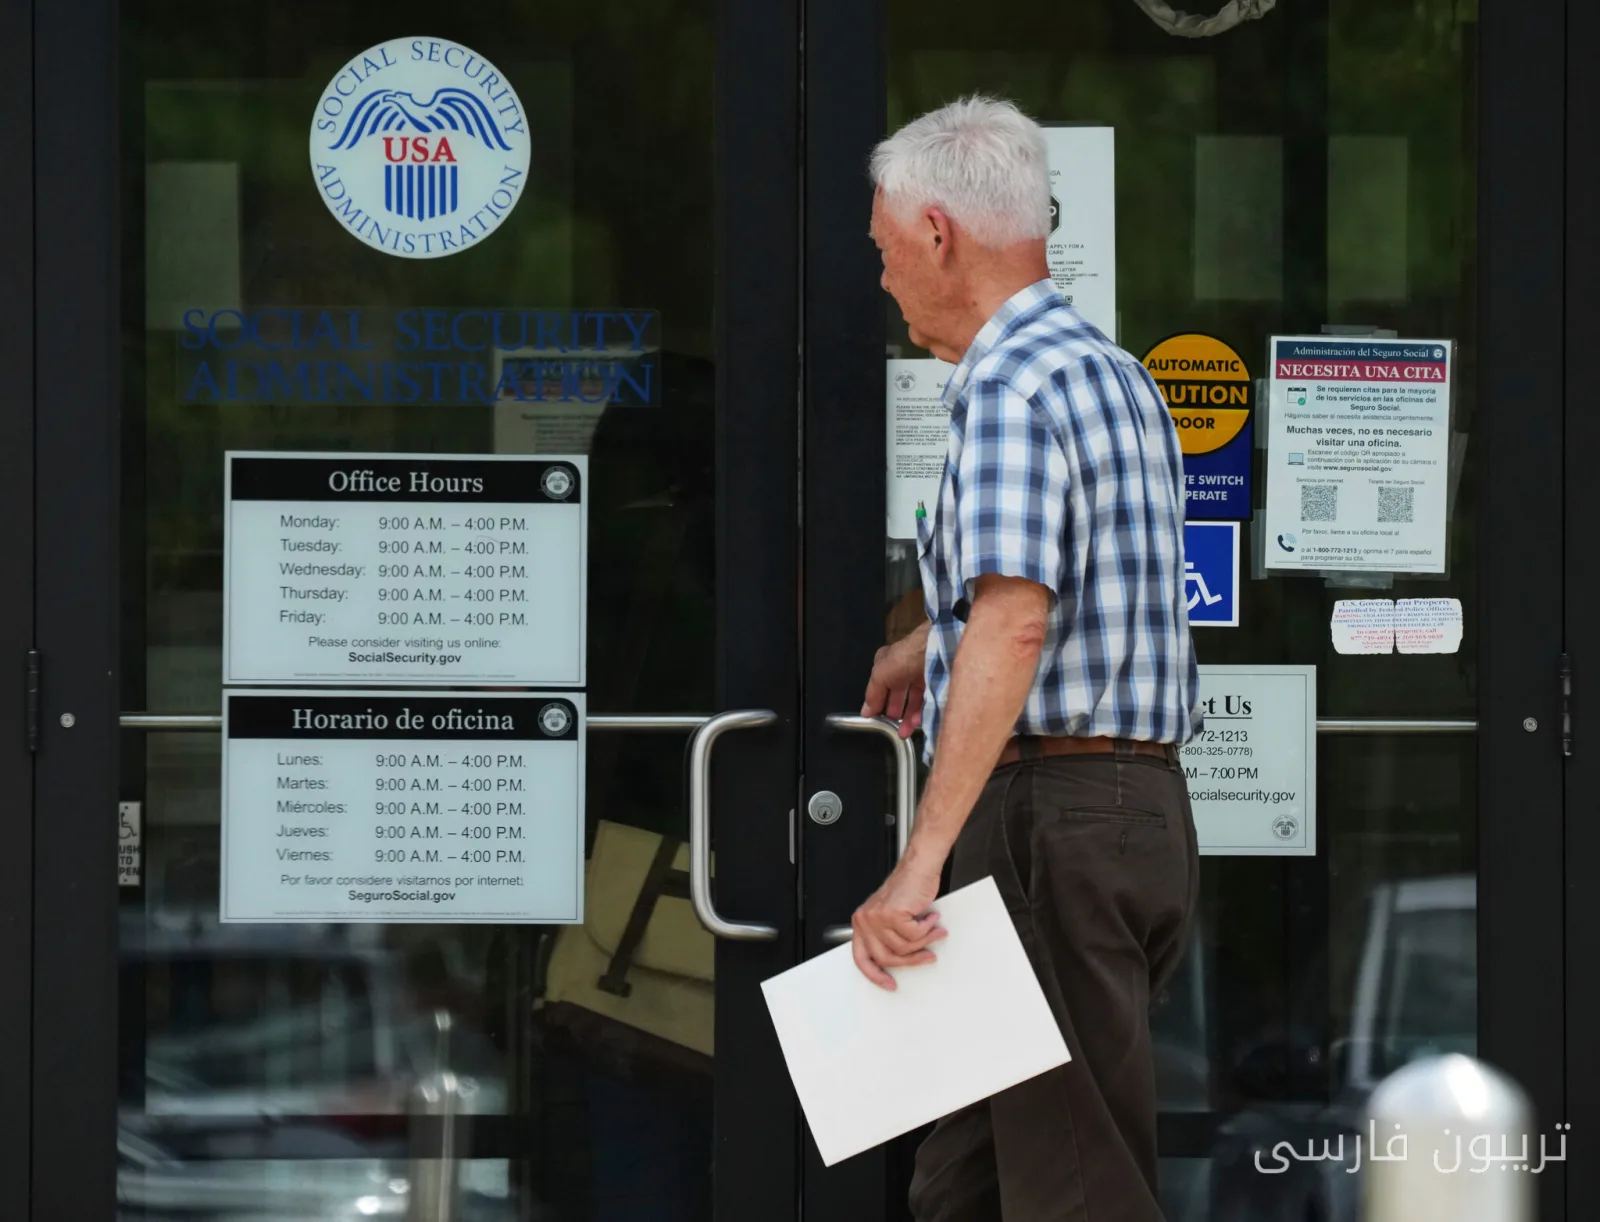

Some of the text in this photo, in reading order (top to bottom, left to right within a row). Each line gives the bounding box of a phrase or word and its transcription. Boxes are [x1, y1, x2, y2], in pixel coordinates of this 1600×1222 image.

[317, 41, 524, 135] SOCIAL SECURITY
[382, 137, 457, 163] USA
[316, 163, 522, 253] ADMINISTRATION
[180, 308, 655, 353] SOCIAL SECURITY
[1293, 346, 1429, 358] Administración del Seguro Social
[1147, 358, 1239, 372] AUTOMATIC
[1279, 364, 1443, 379] NECESITA UNA CITA
[184, 360, 654, 404] ADMINISTRATION
[1157, 384, 1248, 404] AUTION
[1328, 385, 1362, 394] requieren
[1382, 387, 1398, 395] para
[1400, 386, 1406, 394] la
[1408, 387, 1436, 395] mayoría
[1350, 404, 1402, 412] Seguro Social.
[1286, 425, 1433, 437] Muchas veces, no es necesario
[1316, 438, 1346, 446] visitar
[1367, 438, 1402, 448] oficina.
[328, 470, 484, 493] Office Hours
[1198, 474, 1244, 486] SWITCH
[1185, 490, 1228, 501] PERATE
[280, 514, 529, 531] Monday: 9:00 A.M. 4:00 P.M.
[280, 538, 529, 555] Tuesday: 9:00 A.M. 4:00 P.M.
[279, 562, 529, 579] Wednesday: 9:00 A.M. 4:00 P.M.
[279, 586, 529, 603] Thursday: 9:00 A.M. 4:00 P.M.
[1414, 599, 1450, 608] Property
[279, 609, 529, 626] Friday: 9:00 A.M. 4:00 P.M.
[308, 636, 501, 650] Please consider visiting us online:
[348, 651, 462, 665] SocialSecurity.gov
[1224, 695, 1252, 715] Us
[292, 708, 388, 731] Horario
[395, 708, 424, 731] de
[431, 708, 514, 731] oficina
[1200, 730, 1248, 742] 72-1213
[1180, 746, 1253, 758] -800-325-0778)
[277, 752, 526, 768] Lunes: 9:00 A.M. 4:00 P.M.
[1185, 766, 1258, 780] M 7:00 PM
[276, 776, 526, 792] Martes: 9:00 A.M. 4:00 P.M.
[276, 800, 526, 816] Miércoles: 9:00 A.M. 4:00 P.M.
[276, 824, 526, 840] Jueves: 9:00 A.M. 4:00 P.M.
[120, 844, 140, 855] USH
[276, 848, 526, 864] Viernes: 9:00 A.M. 4:00 P.M.
[120, 856, 133, 866] TO
[120, 867, 140, 876] PEN
[280, 874, 301, 886] Por
[304, 874, 334, 886] favor
[336, 875, 393, 886] considere
[455, 878, 474, 888] por
[348, 890, 456, 904] SeguroSocial.gov
